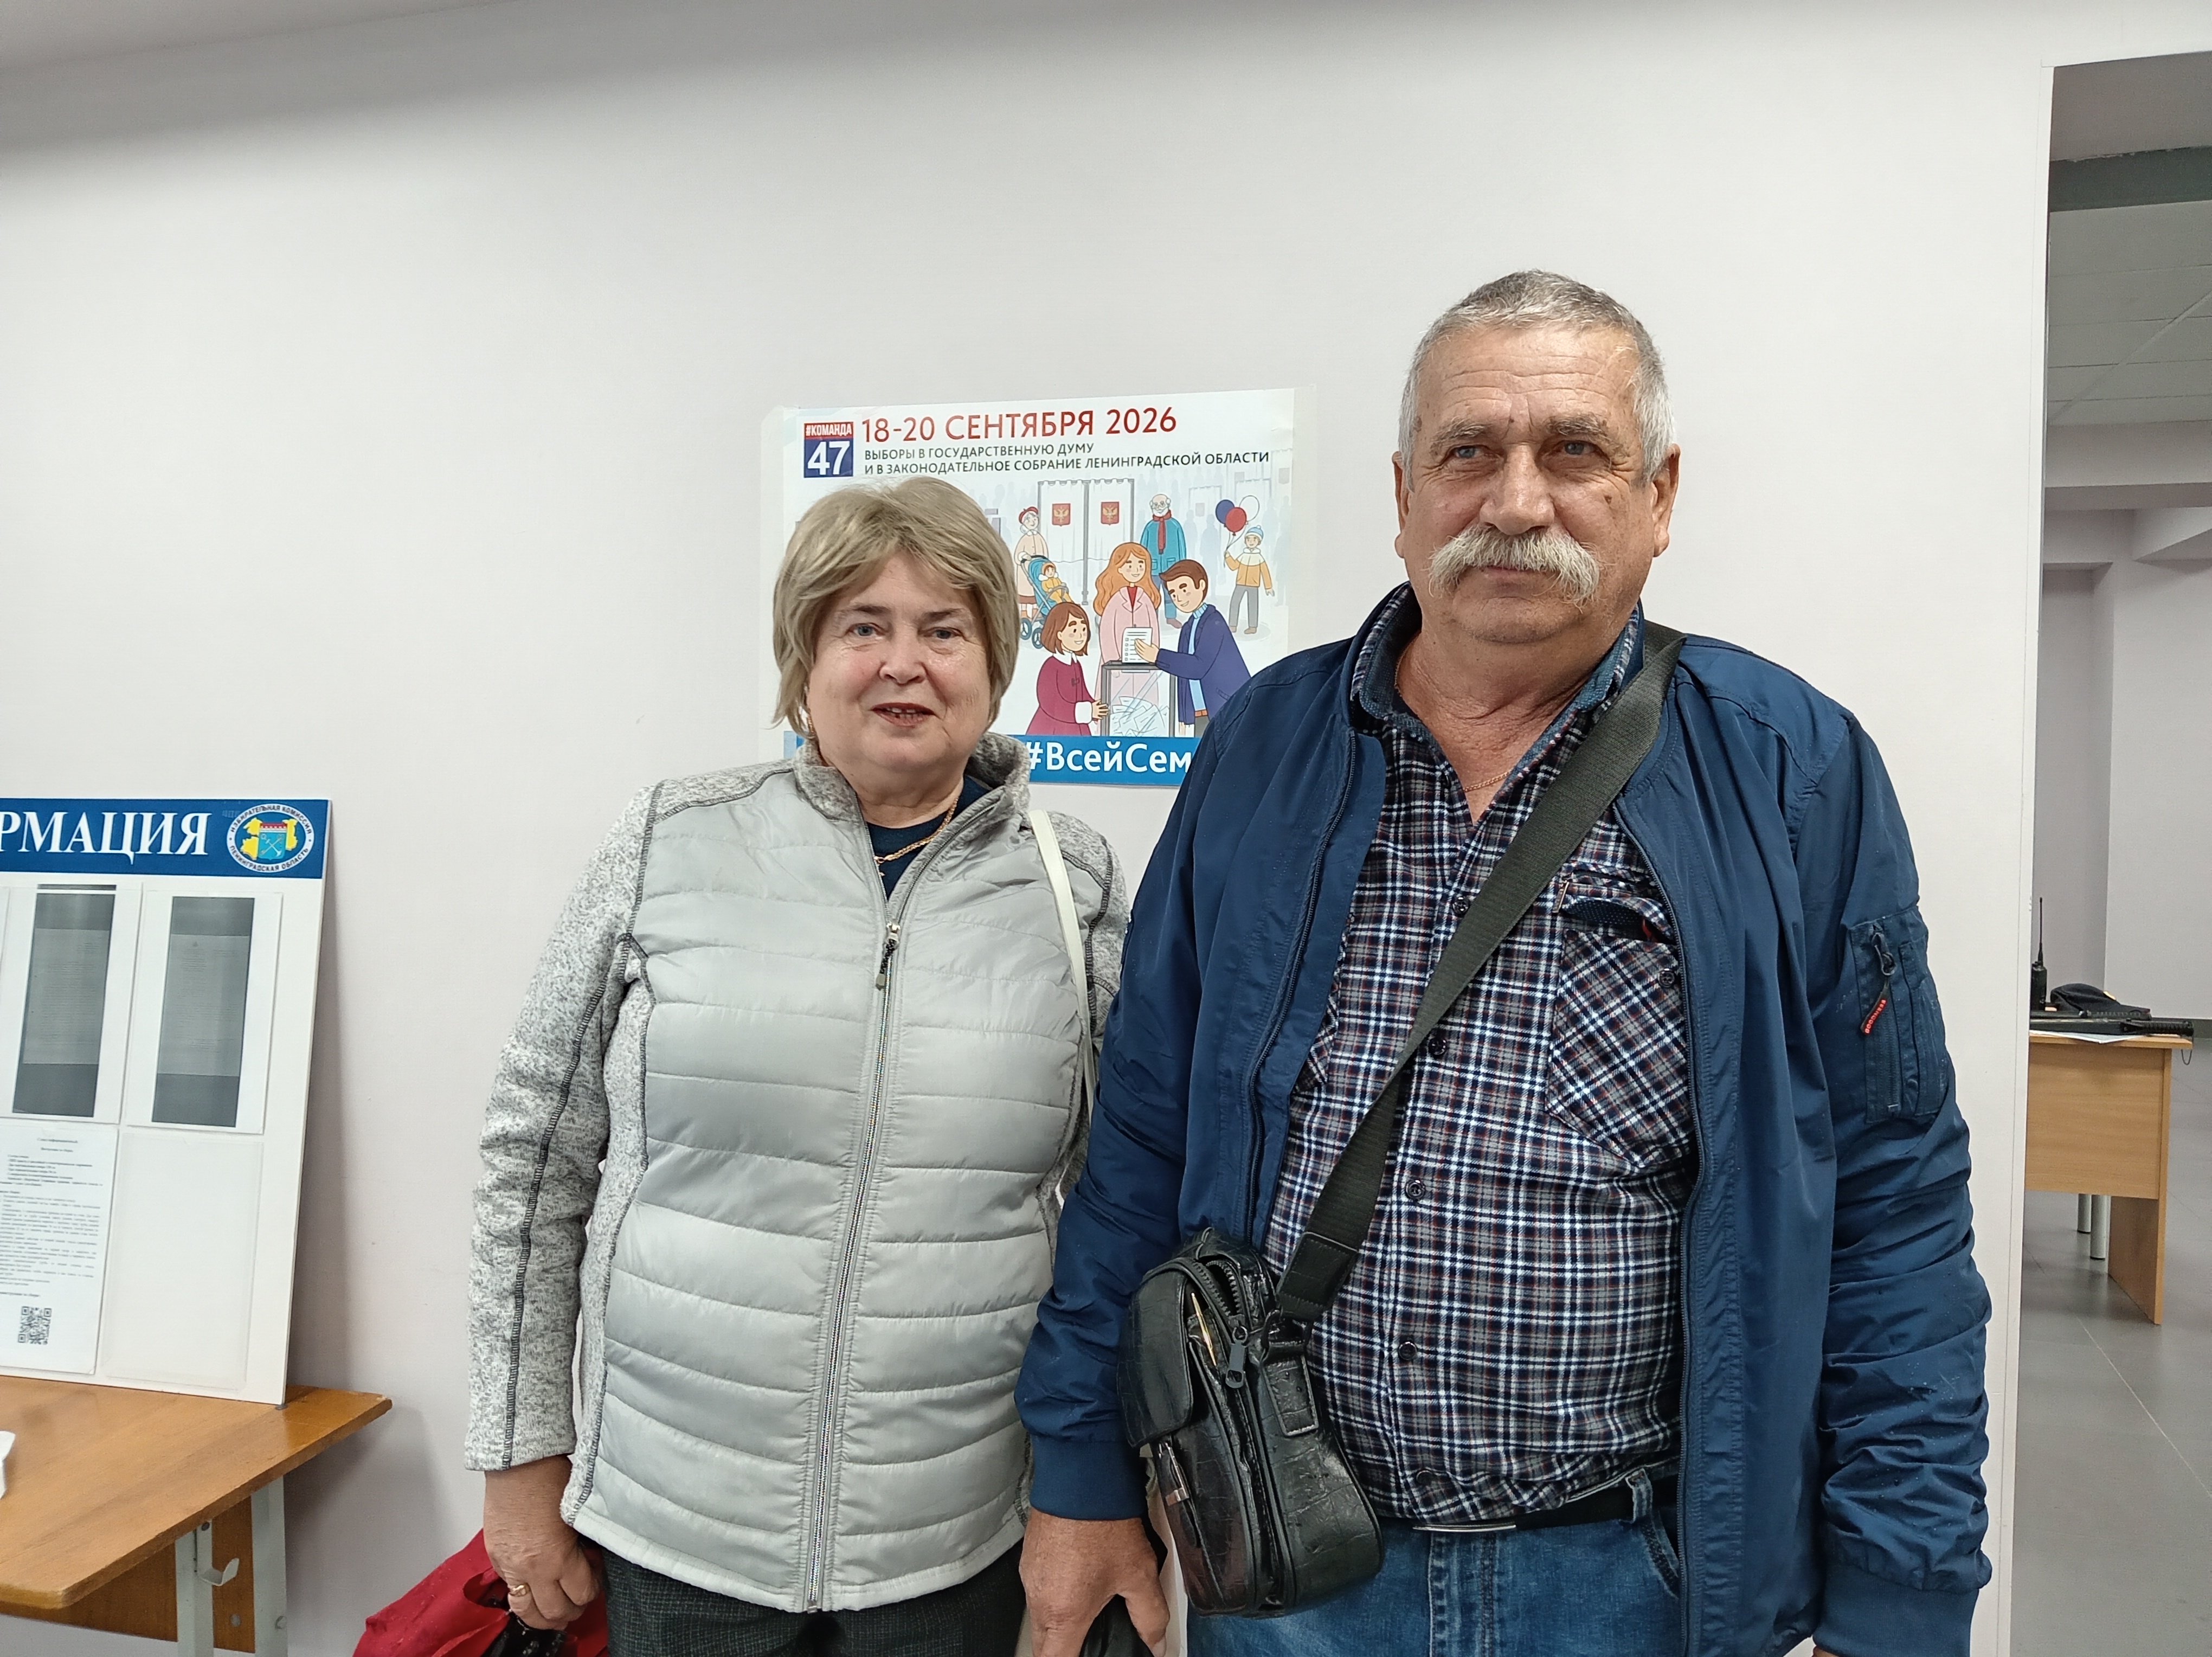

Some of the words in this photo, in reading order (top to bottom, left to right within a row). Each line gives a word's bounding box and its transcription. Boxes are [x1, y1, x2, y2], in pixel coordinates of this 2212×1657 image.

[805, 423, 852, 437] #КОМАНДА
[861, 416, 935, 442] 18-20
[946, 410, 1094, 440] СЕНТЯБРЯ
[1106, 407, 1176, 434] 2026
[807, 441, 850, 476] 47
[865, 448, 915, 460] ВЫБОРЫ
[918, 449, 925, 459] В
[929, 444, 1054, 460] ГОСУДАРСТВЕННУЮ
[1057, 443, 1094, 457] ДУМУ
[865, 465, 873, 474] И
[877, 465, 883, 474] В
[886, 461, 1011, 475] ЗАКОНОДАТЕЛЬНОЕ
[1014, 459, 1081, 471] СОБРАНИЕ
[1085, 452, 1201, 468] ЛЕНИНГРАДСКОЙ
[1205, 452, 1269, 465] ОБЛАСТИ
[230, 805, 281, 833] ИЗБИРАТЕЛЬНАЯ
[282, 806, 312, 834] КОМИССИЯ
[230, 845, 280, 872] ЛЕНИНГРАДСКАЯ
[281, 848, 309, 870] ОБЛАСТЬ
[1865, 999, 1886, 1033] GOODNESS
